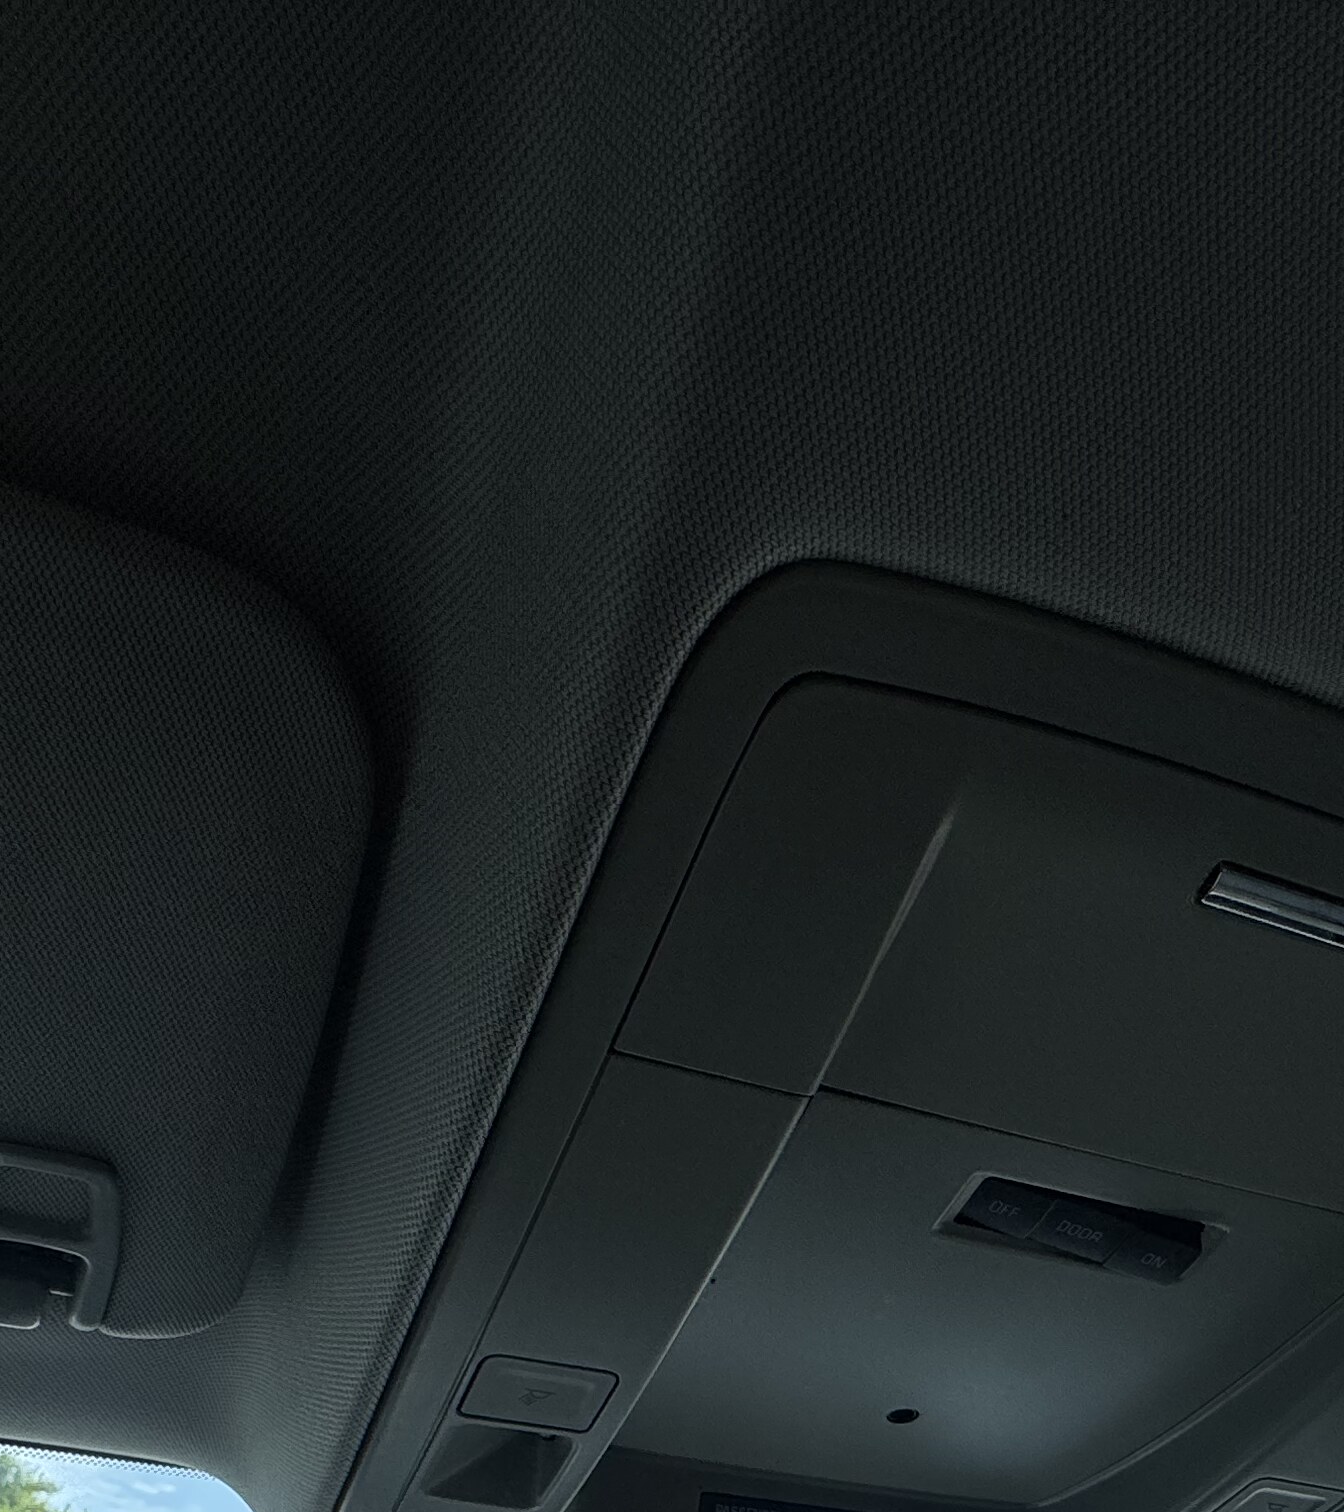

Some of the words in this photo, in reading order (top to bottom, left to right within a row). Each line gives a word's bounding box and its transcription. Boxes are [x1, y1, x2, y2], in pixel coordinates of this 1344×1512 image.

[988, 1200, 1022, 1217] OFF
[1056, 1220, 1105, 1242] DOOR
[1141, 1253, 1167, 1268] ON
